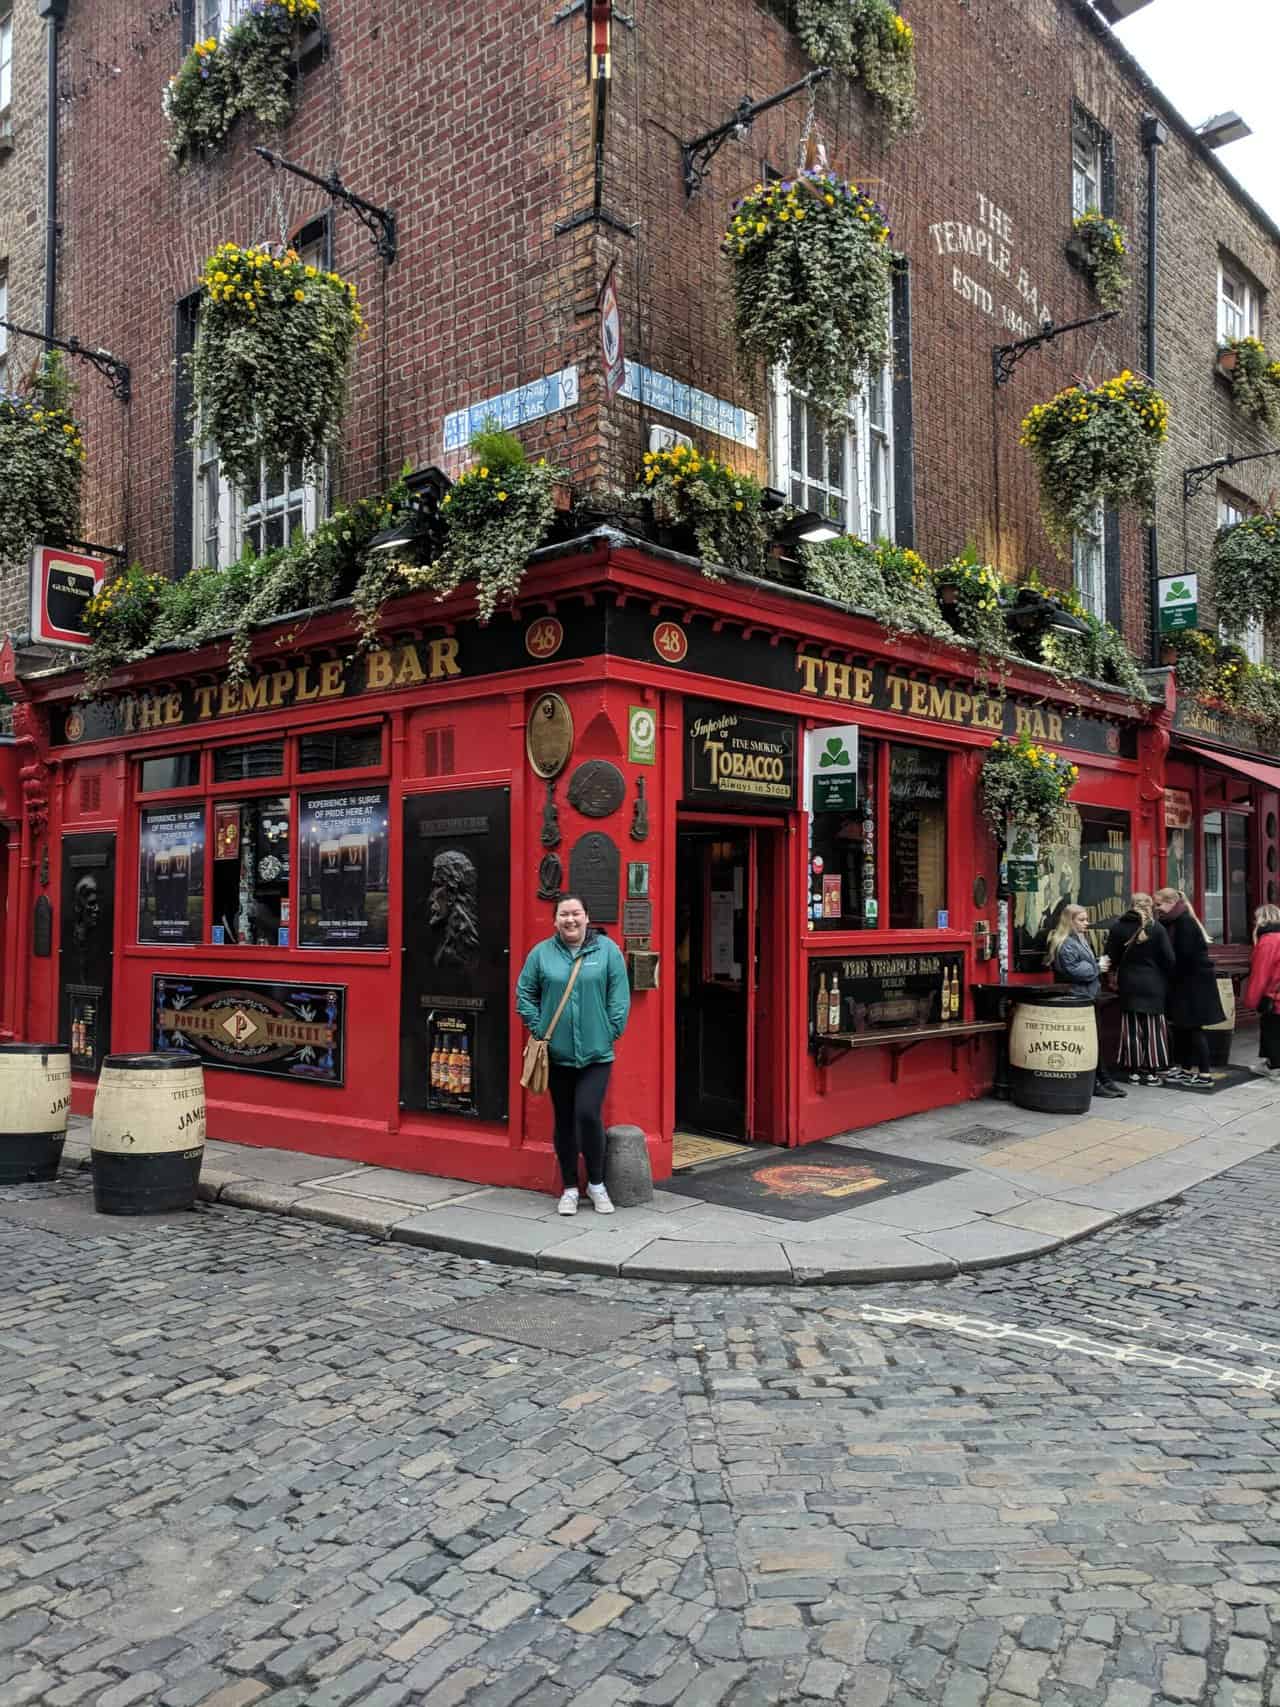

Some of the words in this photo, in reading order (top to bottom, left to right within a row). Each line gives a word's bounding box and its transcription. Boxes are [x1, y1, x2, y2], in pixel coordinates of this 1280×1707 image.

[976, 191, 1014, 246] THE
[928, 220, 1010, 278] TEMPLE
[531, 624, 555, 649] 48
[659, 626, 681, 653] 48
[116, 688, 184, 731] THE
[193, 659, 346, 720] TEMPLE
[365, 637, 462, 690] BAR
[796, 655, 874, 705] THE
[887, 674, 1003, 731] TEMPLE
[1015, 704, 1064, 743] BAR
[690, 714, 738, 741] Importers
[720, 730, 728, 738] OF
[732, 738, 749, 750] FINE
[750, 742, 783, 754] SMOKING
[704, 741, 784, 785] TOBACCO
[720, 779, 751, 791] Always
[307, 798, 348, 809] EXPERIENCE
[314, 810, 324, 818] OF
[325, 808, 345, 817] PRIDE
[345, 807, 364, 816] HERE
[364, 806, 374, 815] AT
[843, 960, 868, 978] THE
[871, 958, 917, 977] TEMPLE
[919, 956, 940, 975] BAR
[174, 1013, 216, 1029] POWERS
[266, 1022, 320, 1042] WHISKEY
[1025, 1022, 1039, 1030] THE
[1041, 1023, 1073, 1032] TEMPLE
[1028, 1040, 1084, 1055] JAMESON
[1033, 1070, 1078, 1079] CASKMATES
[171, 1090, 190, 1101] THE
